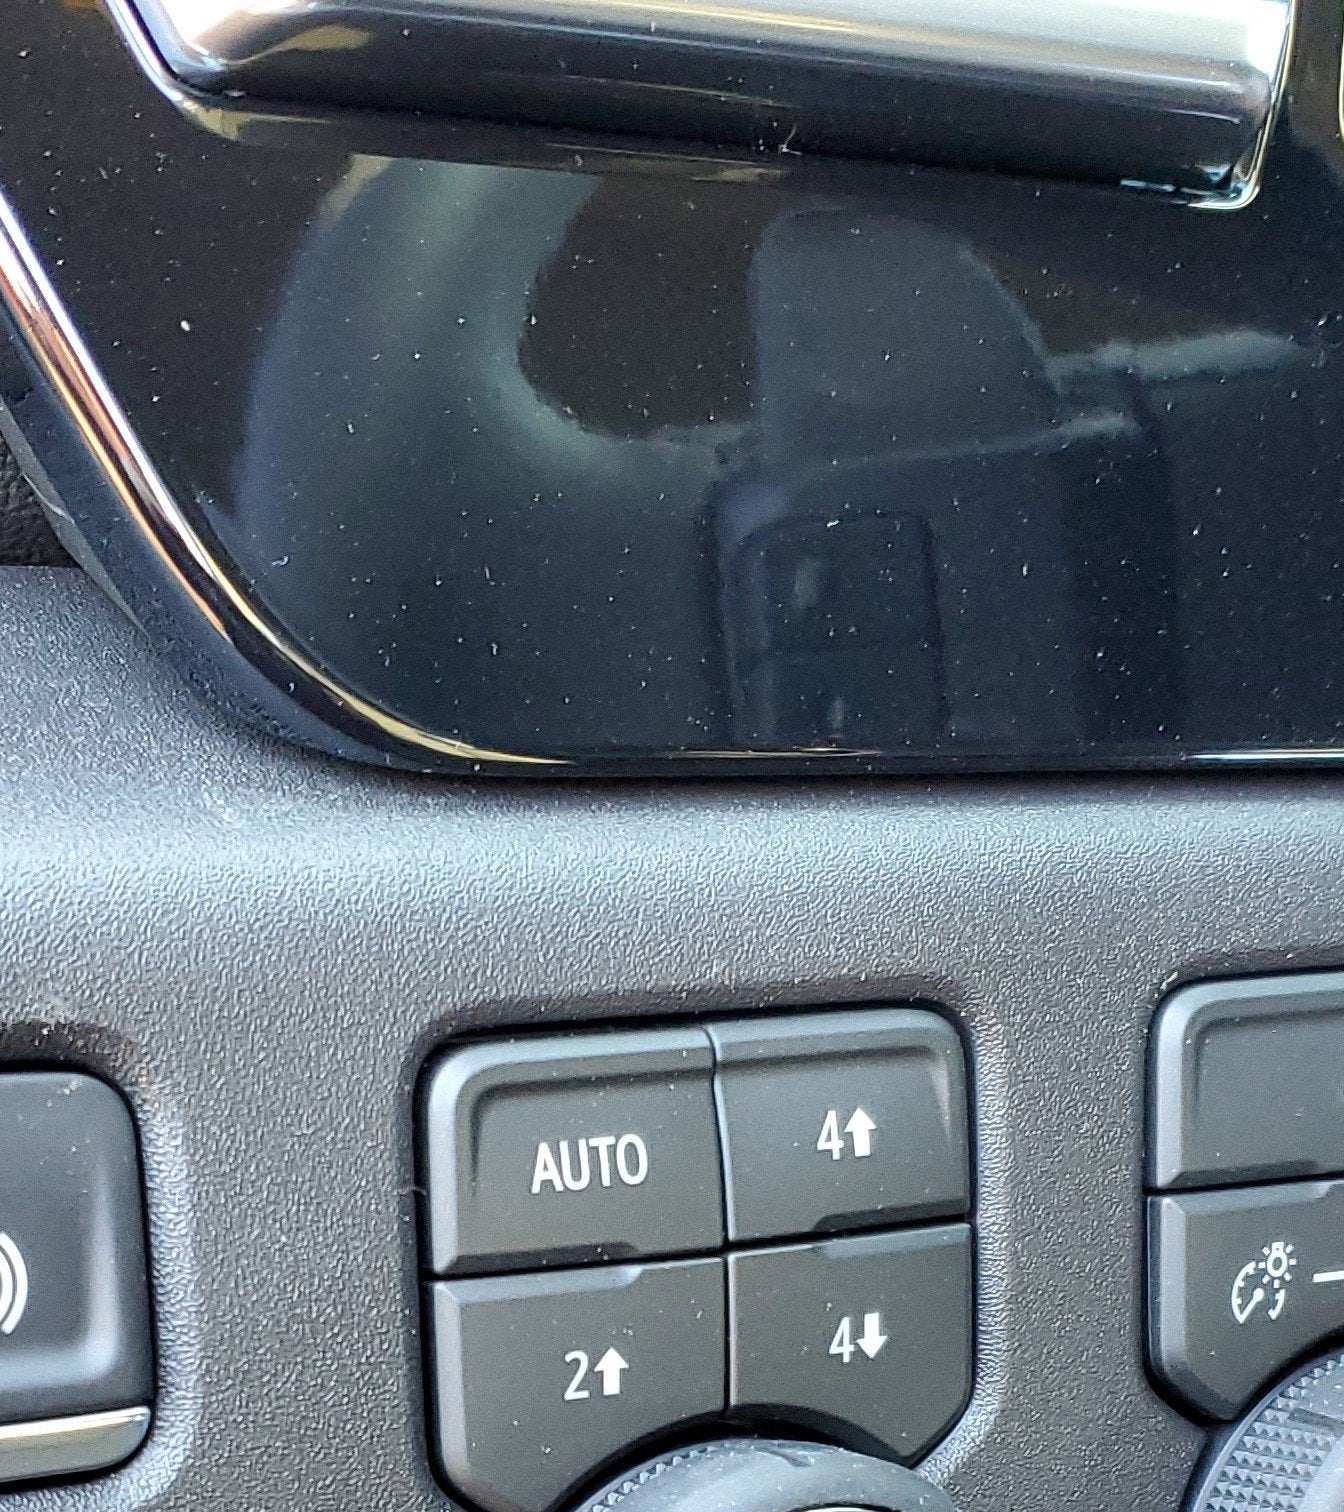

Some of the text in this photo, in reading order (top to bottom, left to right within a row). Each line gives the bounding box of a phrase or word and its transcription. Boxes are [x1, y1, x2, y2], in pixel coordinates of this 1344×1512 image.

[816, 1109, 845, 1161] 4
[530, 1133, 649, 1195] AUTO
[828, 1315, 856, 1364] 4
[562, 1350, 590, 1402] 2
